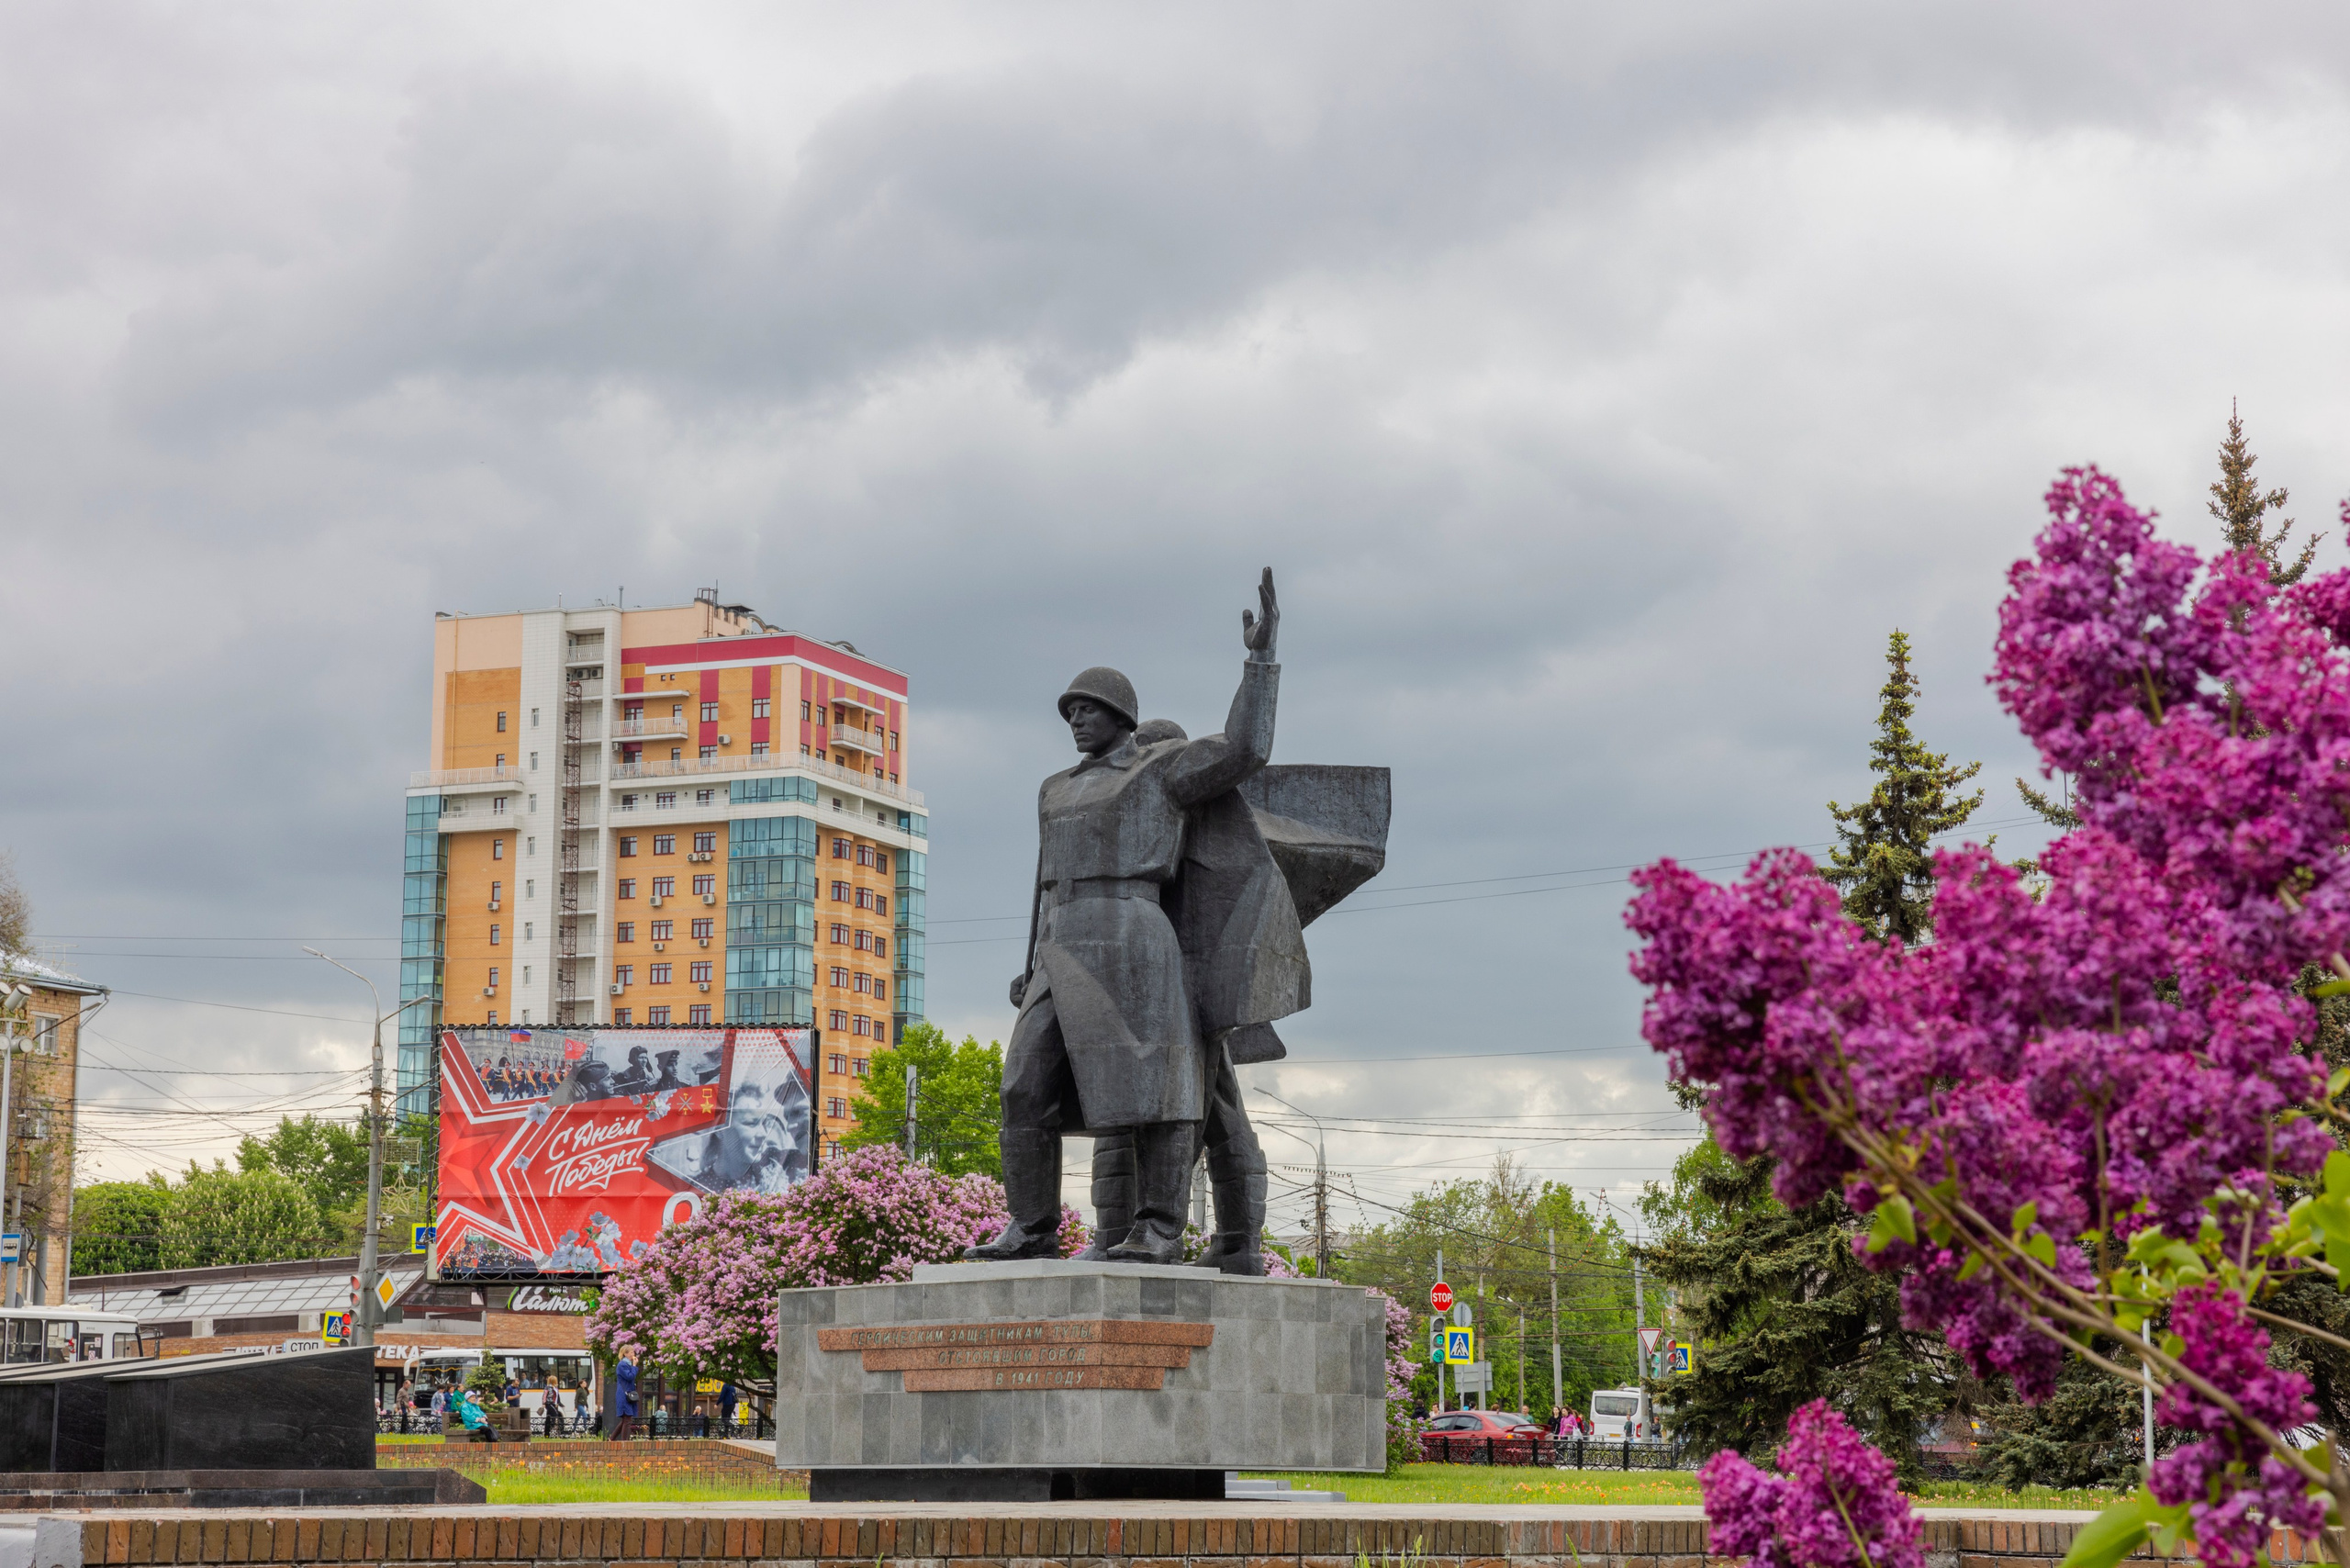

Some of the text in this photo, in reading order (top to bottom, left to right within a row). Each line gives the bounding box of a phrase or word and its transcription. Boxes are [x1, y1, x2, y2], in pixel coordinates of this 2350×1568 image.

[549, 1116, 643, 1160] С Днём
[544, 1141, 650, 1197] Победы!
[512, 1285, 588, 1311] Салют
[1432, 1292, 1452, 1303] STOP
[850, 1329, 944, 1346] ГЕРОИЧЕСКИМ
[949, 1326, 1044, 1343] ЗАЩИТНИКАМ
[938, 1347, 1086, 1364] ОТСТОЯВШИМ ГОРОД
[995, 1371, 1085, 1386] В 1941 ГОДУ
